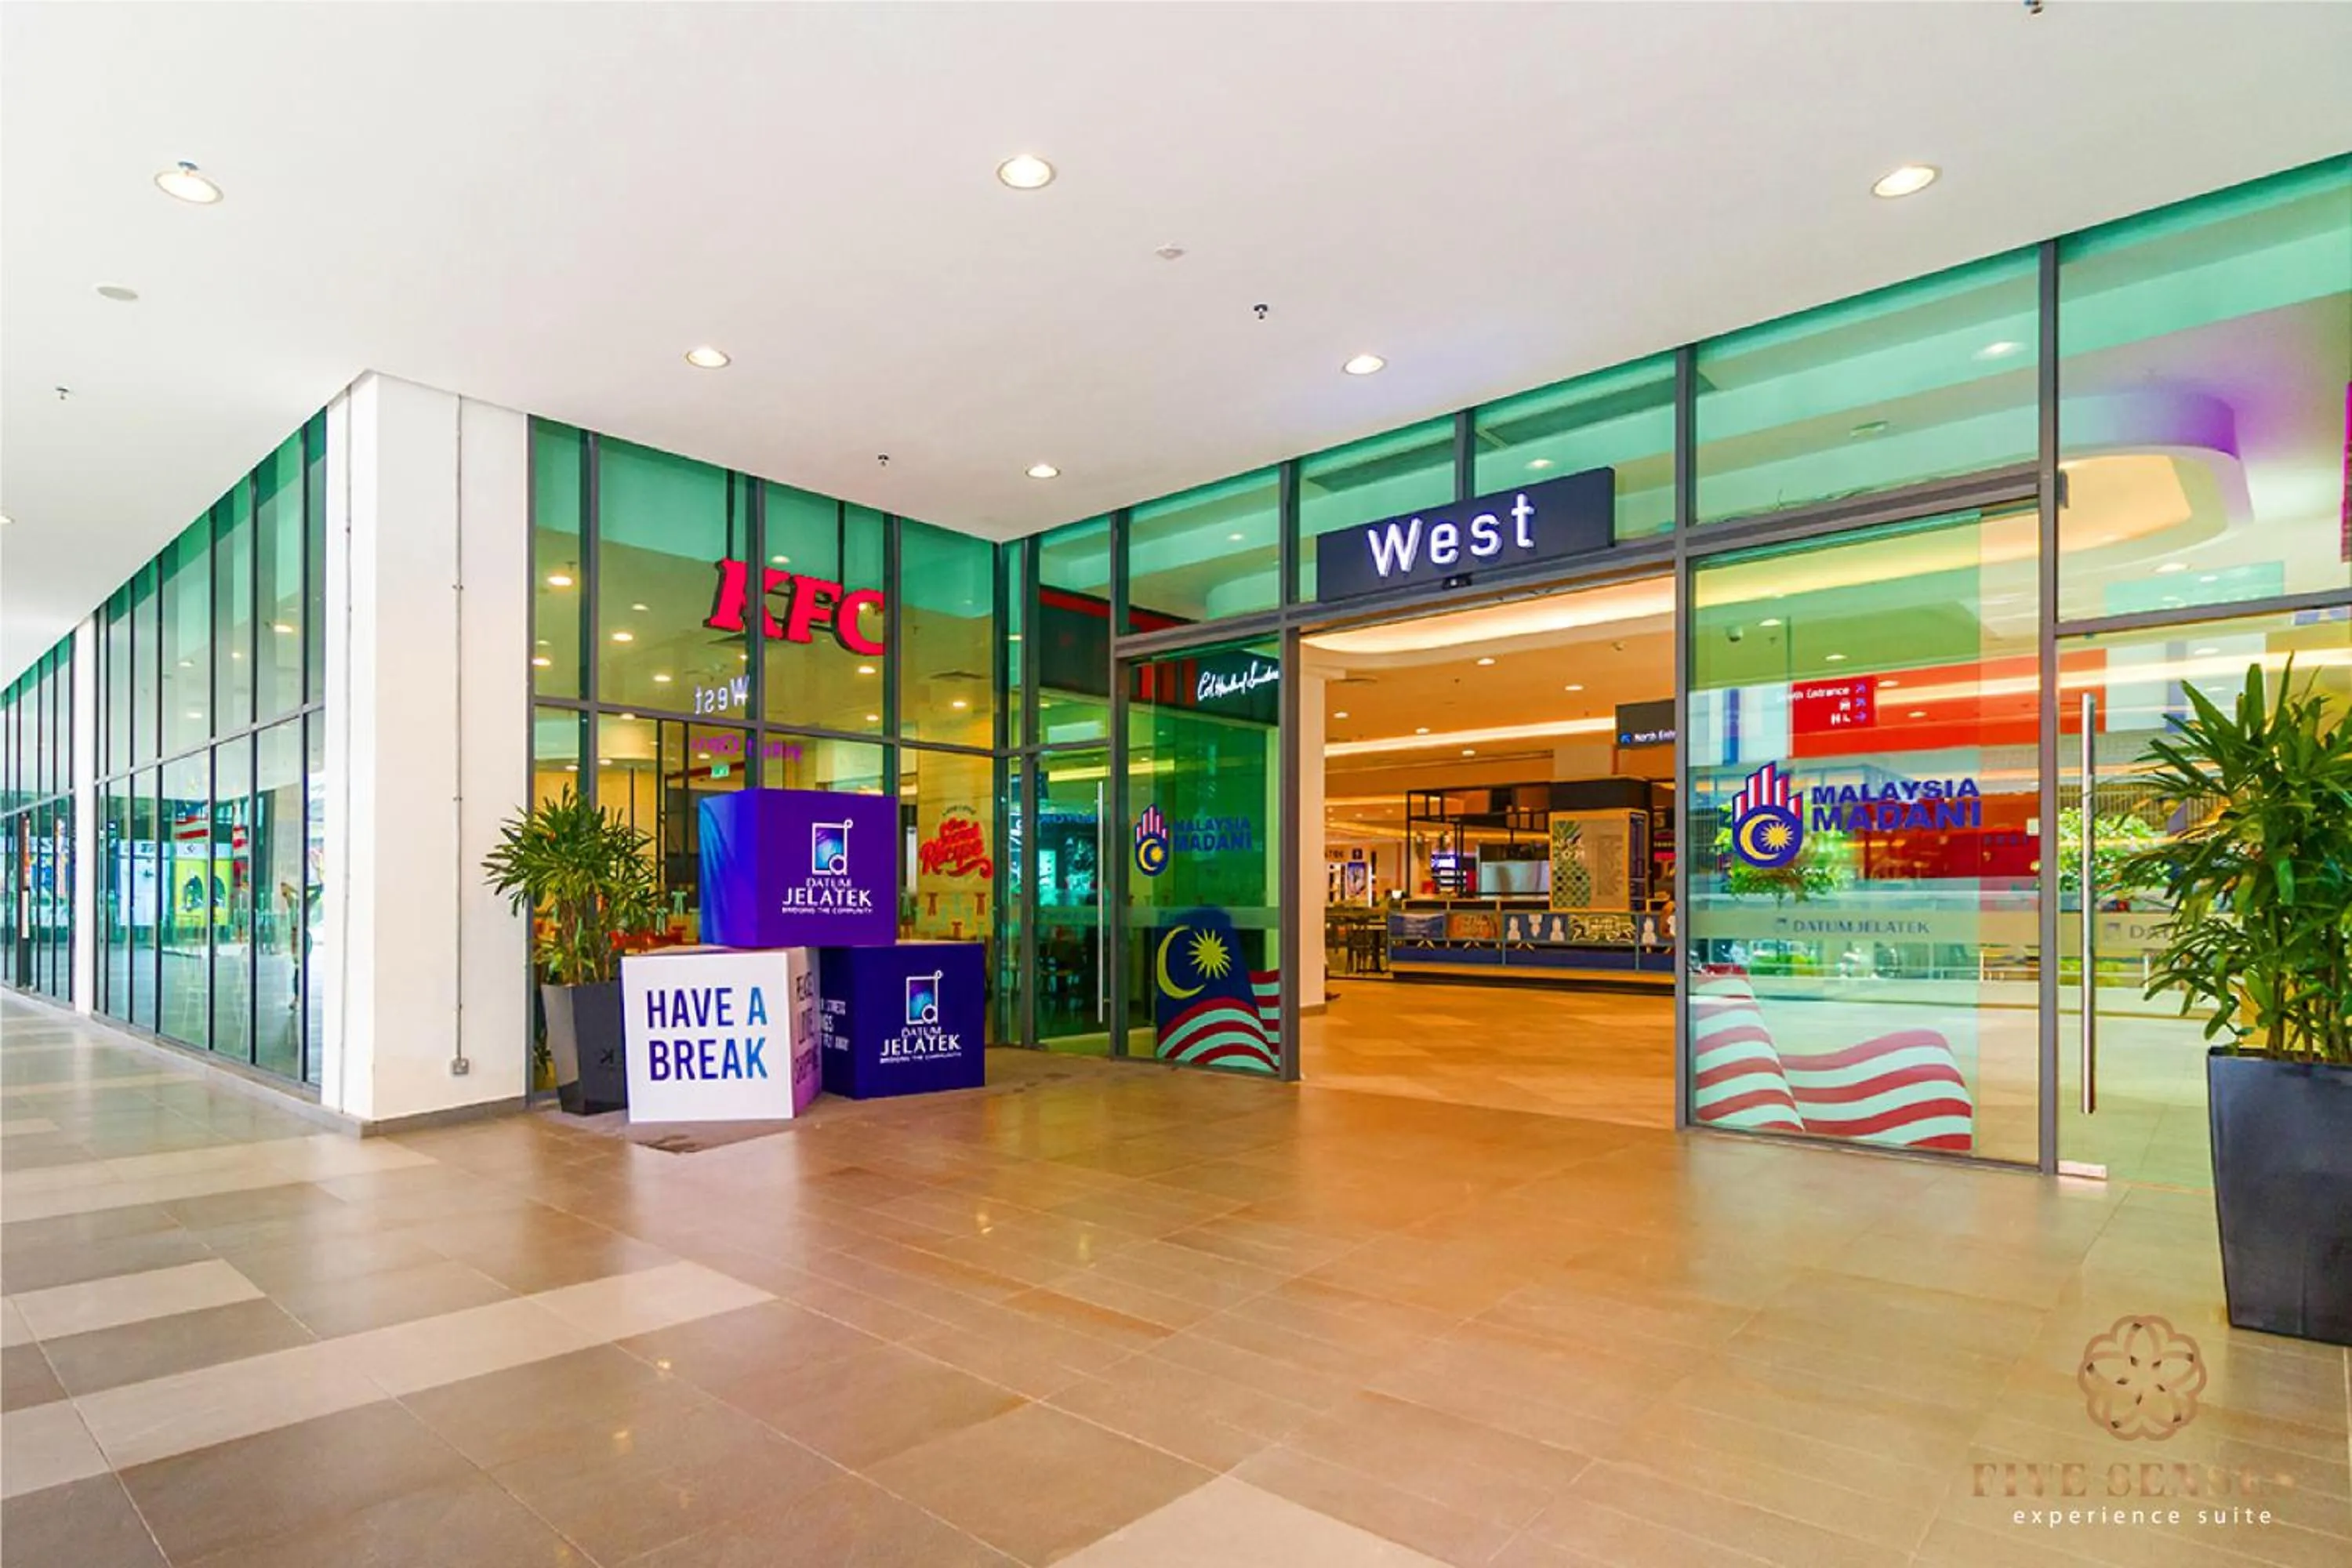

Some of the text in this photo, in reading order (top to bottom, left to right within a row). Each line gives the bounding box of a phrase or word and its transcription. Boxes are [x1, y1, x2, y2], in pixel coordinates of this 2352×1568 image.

[1367, 492, 1535, 577] West
[705, 556, 886, 656] KFC
[1811, 777, 1980, 804] MALAYSIA
[1174, 816, 1251, 832] MALAYSIA
[1811, 800, 1981, 833] MADANI
[1173, 830, 1252, 851] MADANI
[806, 877, 852, 891] DATUM
[782, 887, 872, 906] JELATEK
[1793, 919, 1931, 934] DATUM JELATEK
[647, 987, 733, 1029] HAVE
[746, 985, 768, 1026] A
[901, 1025, 942, 1040] DATUM
[880, 1033, 962, 1056] JELATEK
[648, 1036, 768, 1081] BREAK
